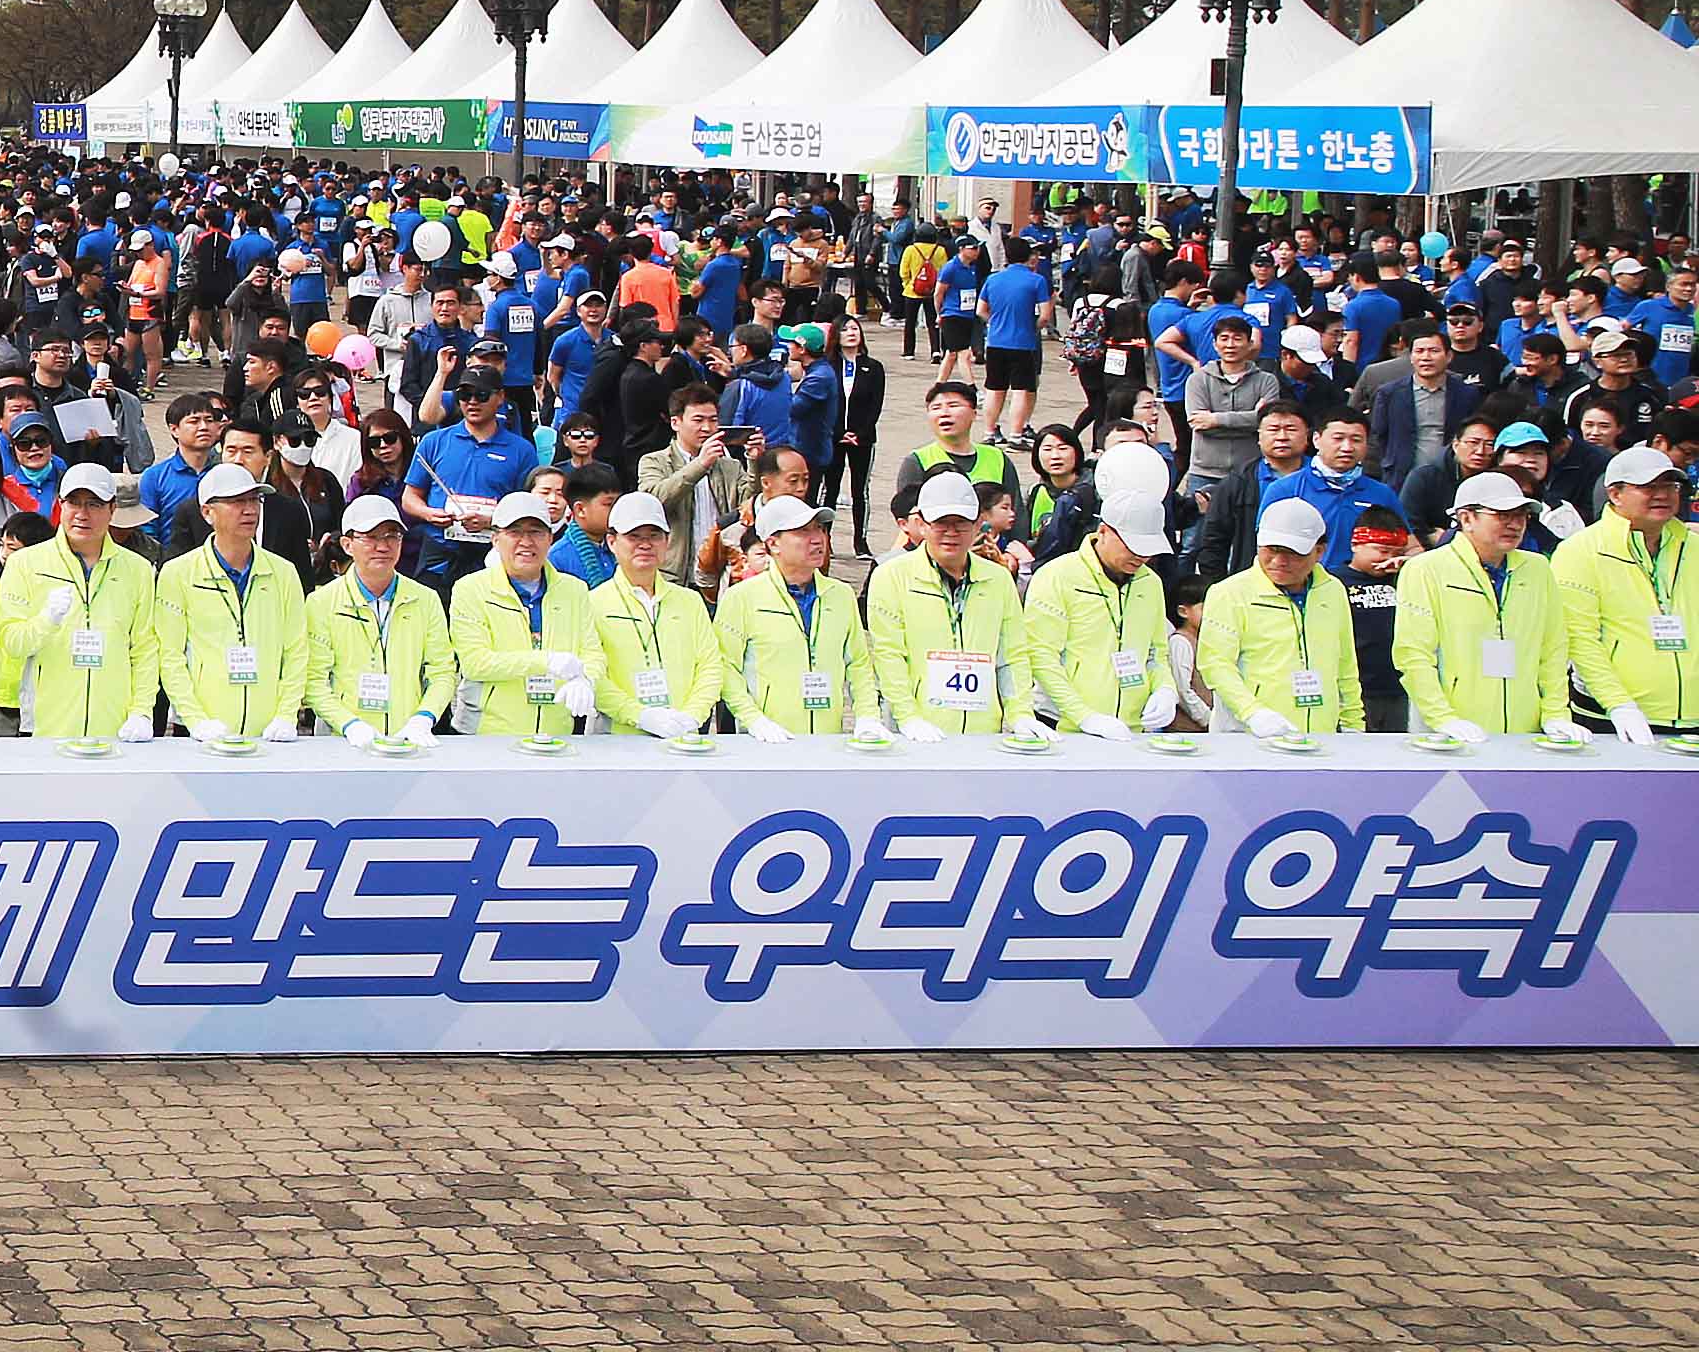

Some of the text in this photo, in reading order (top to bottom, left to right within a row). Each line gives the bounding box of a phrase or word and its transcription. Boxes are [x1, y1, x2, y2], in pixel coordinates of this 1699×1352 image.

[503, 118, 560, 142] HSUNG
[741, 121, 822, 157] 두산중공업
[980, 122, 1098, 167] 한국에너지공단
[946, 672, 979, 693] 40
[129, 834, 643, 988] 만드는
[676, 826, 1170, 985] 우리의
[1228, 827, 1621, 981] 약속!
